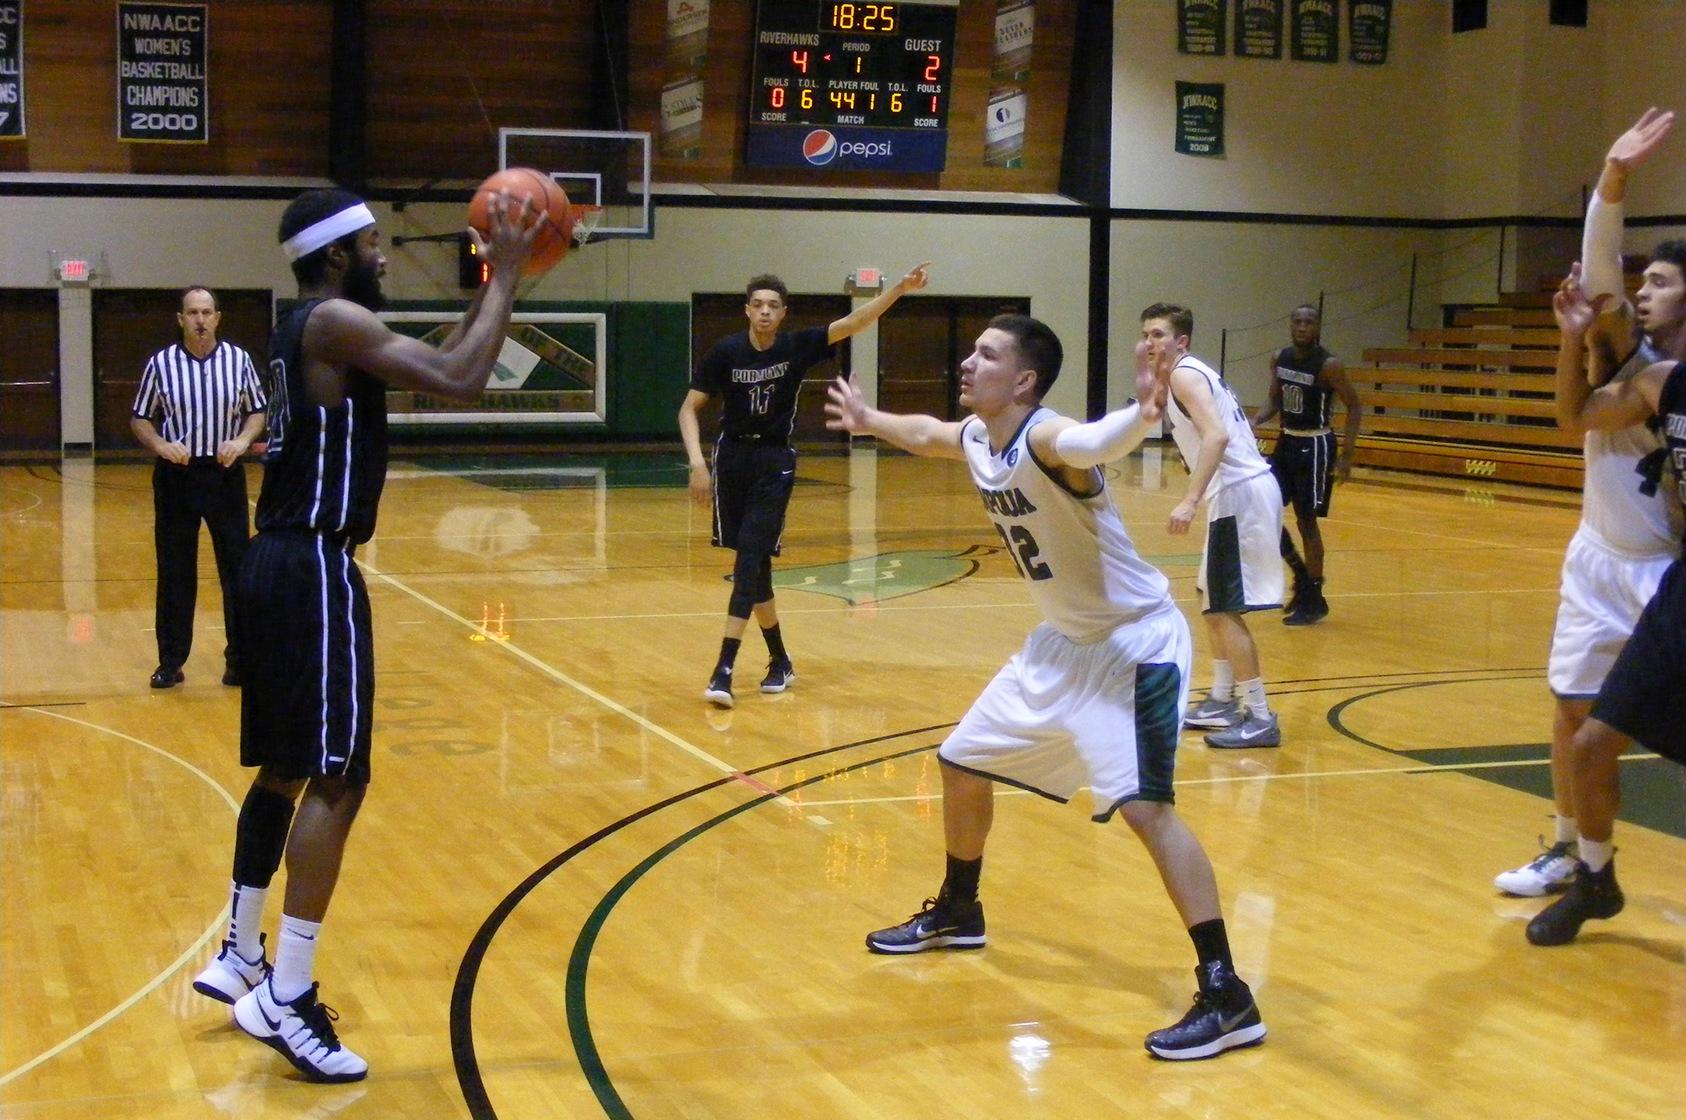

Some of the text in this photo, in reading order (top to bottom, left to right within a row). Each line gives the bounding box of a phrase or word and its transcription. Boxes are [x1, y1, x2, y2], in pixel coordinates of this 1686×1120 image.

[124, 13, 200, 32] NWAACC
[833, 4, 894, 31] 18:25
[134, 38, 191, 56] WOMEN'S
[760, 31, 820, 46] RIVERHAWKS
[842, 42, 870, 51] PERIOD
[905, 38, 941, 52] GUEST
[0, 58, 19, 75] LL
[121, 62, 204, 80] BASKETBALL
[792, 51, 808, 74] 4
[856, 57, 861, 74] 1
[925, 55, 940, 81] 2
[763, 77, 789, 87] FOULS
[829, 80, 879, 91] PLAYER FOUL
[917, 84, 941, 93] FOULS
[127, 85, 199, 107] CHAMPIONS
[772, 88, 785, 108] 0
[800, 89, 813, 109] 6
[830, 92, 855, 110] 44
[891, 94, 902, 113] 6
[931, 95, 937, 113] 1
[131, 113, 198, 131] 2000
[761, 112, 787, 122] SCORE
[837, 115, 864, 125] MATCH
[914, 118, 939, 128] SCORE
[839, 140, 891, 159] pepsi
[994, 522, 1053, 581] 12
